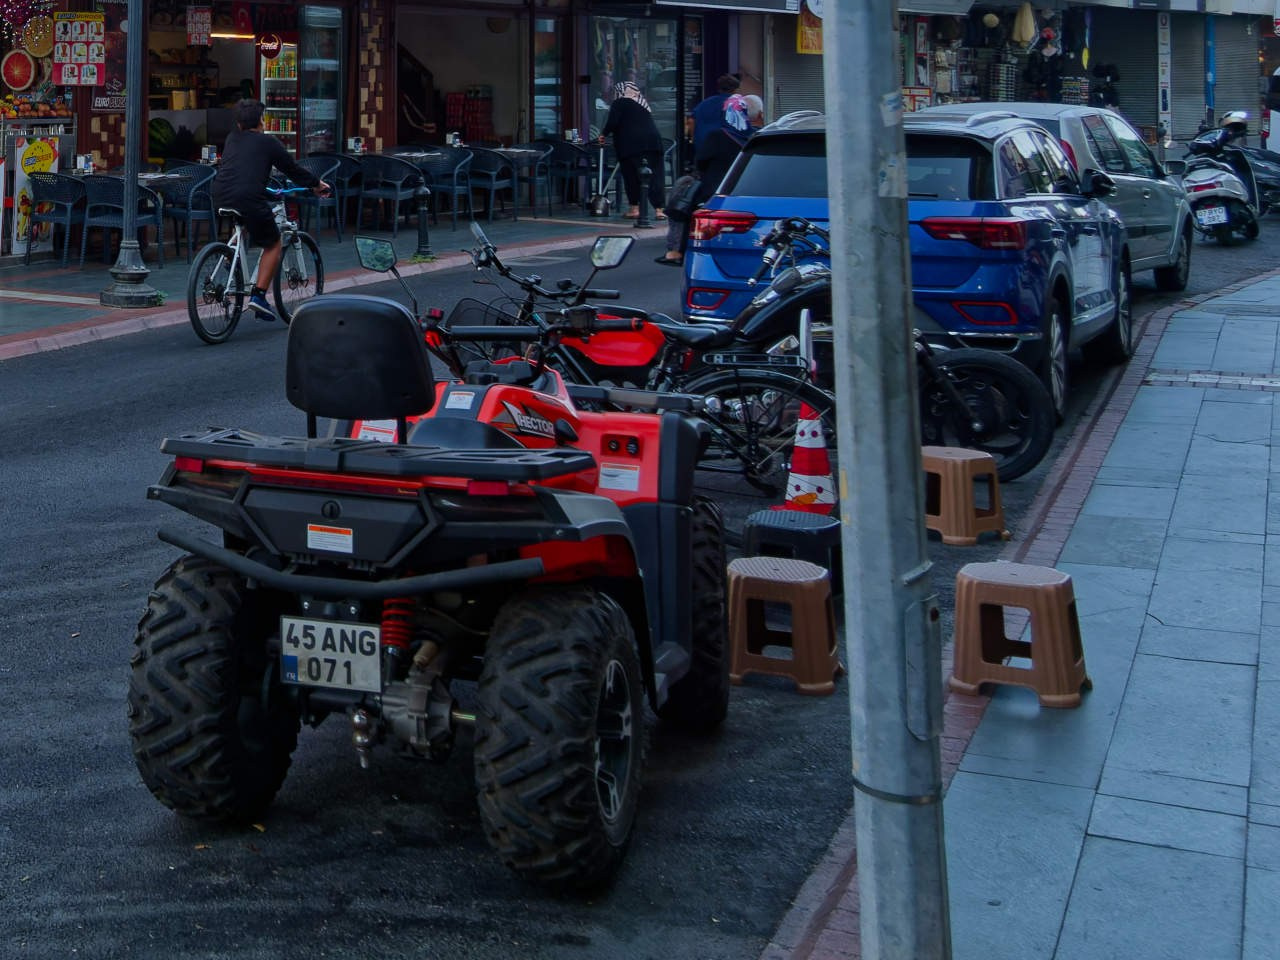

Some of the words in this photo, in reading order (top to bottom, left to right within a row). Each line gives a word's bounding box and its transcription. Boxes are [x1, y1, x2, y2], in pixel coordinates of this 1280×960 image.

[519, 413, 555, 433] HECTOR
[286, 623, 316, 650] 45
[321, 627, 376, 656] ANG
[307, 657, 352, 685] 071
